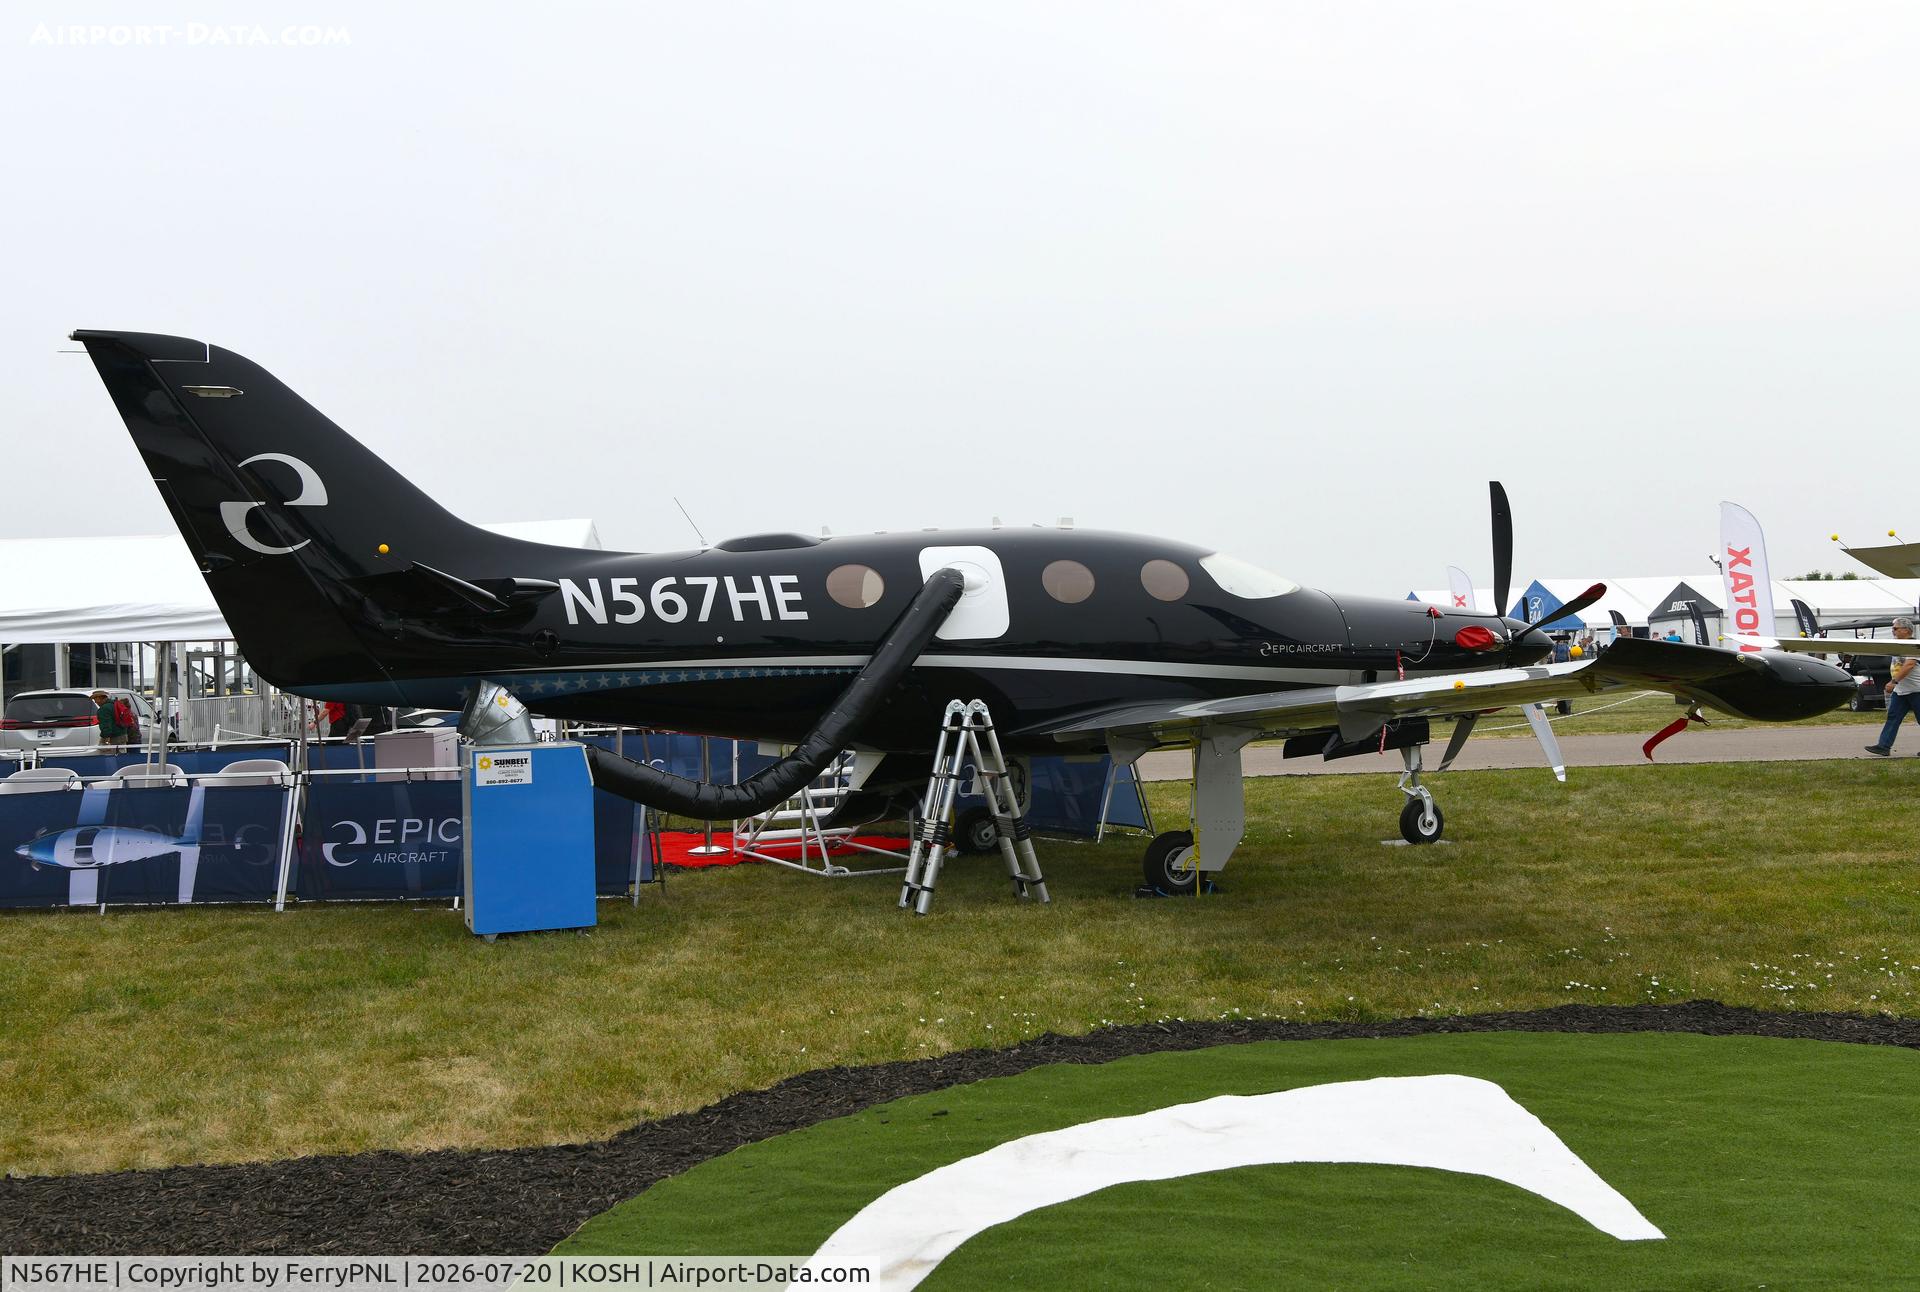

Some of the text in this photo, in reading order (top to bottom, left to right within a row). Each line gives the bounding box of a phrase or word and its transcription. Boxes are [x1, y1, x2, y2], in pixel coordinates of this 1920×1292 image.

[559, 575, 809, 626] N567HE
[1272, 643, 1343, 654] EPIC AIRCRAFT
[493, 757, 529, 766] SUNBELT
[374, 817, 462, 844] EPIC
[372, 851, 449, 864] AIRCRAFT
